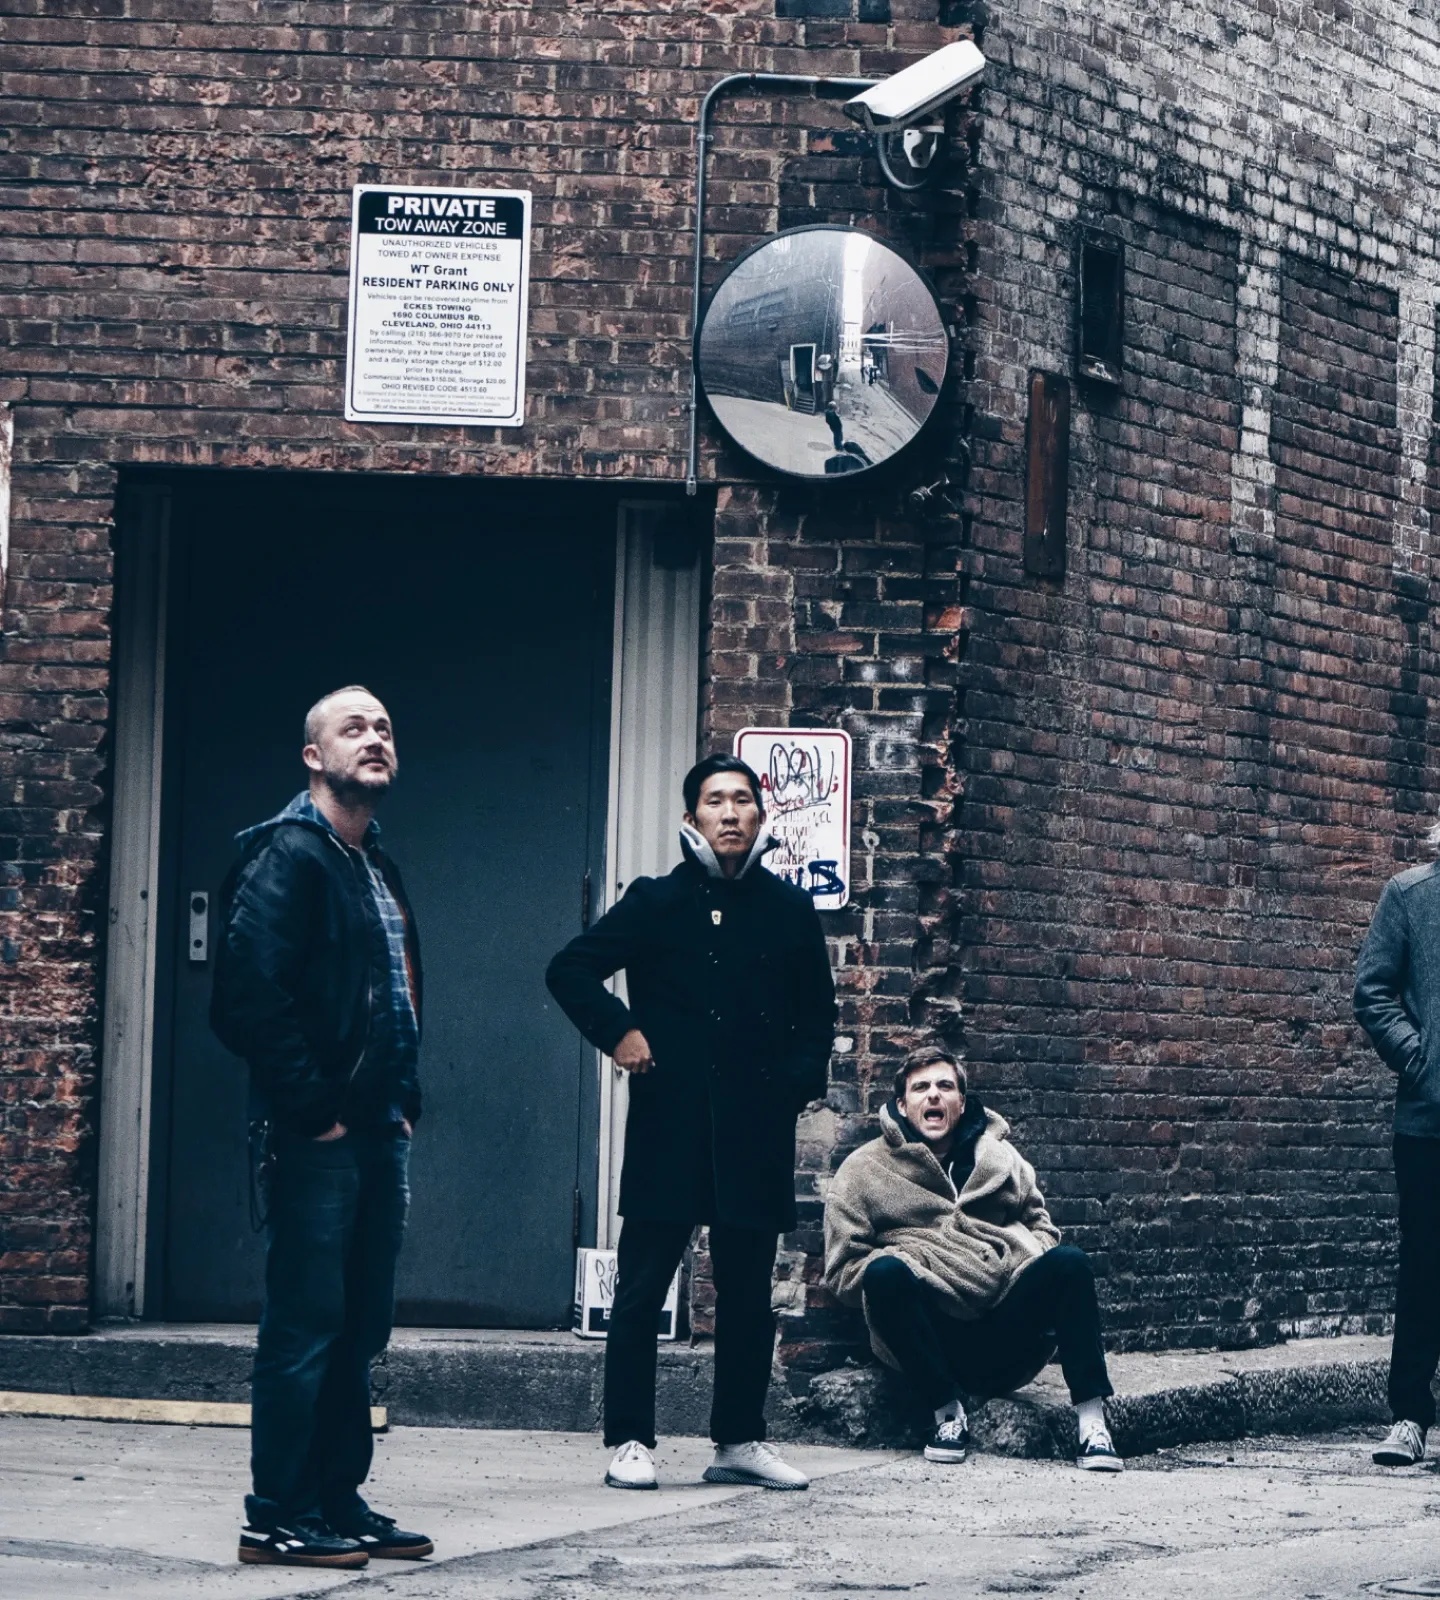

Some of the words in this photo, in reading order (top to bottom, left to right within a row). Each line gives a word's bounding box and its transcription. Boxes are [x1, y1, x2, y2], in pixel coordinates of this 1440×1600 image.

[387, 196, 496, 218] PRIVATE
[374, 217, 411, 231] TOW
[414, 219, 459, 233] AWAY
[462, 220, 506, 235] ZONE
[382, 239, 451, 248] UNAUTHORIZED
[454, 241, 497, 250] VEHICLES
[377, 249, 409, 257] TOWED
[424, 251, 458, 259] OWNER
[460, 253, 500, 261] EXPENSE
[410, 264, 429, 273] WT
[433, 265, 467, 275] Grant
[362, 277, 422, 288] RESIDENT
[425, 279, 478, 290] PARKING
[482, 282, 514, 292] ONLY
[415, 312, 464, 320] COLUMBUS
[381, 320, 437, 328] CLEVELAND,
